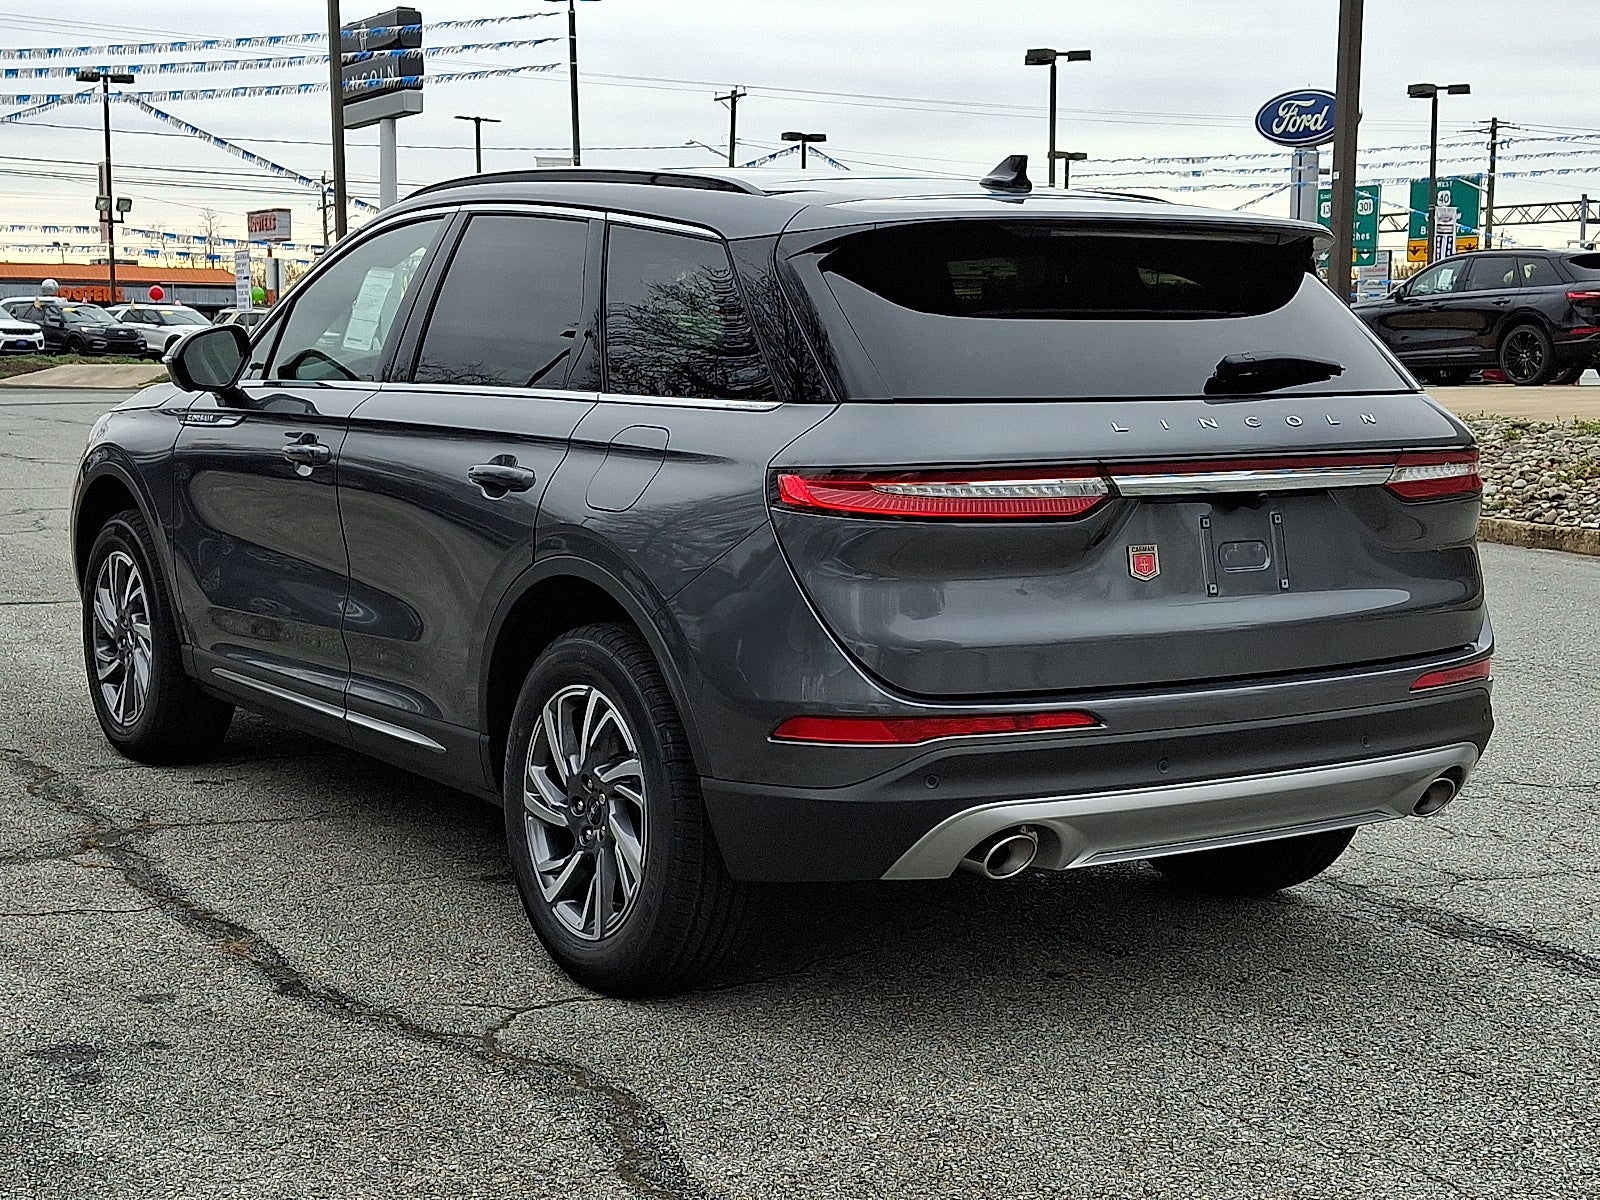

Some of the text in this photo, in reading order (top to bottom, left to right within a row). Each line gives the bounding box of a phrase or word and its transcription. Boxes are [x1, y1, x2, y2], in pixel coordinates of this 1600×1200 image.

[344, 64, 395, 92] INCOLN
[1272, 99, 1329, 134] Ford
[1359, 202, 1372, 213] 301
[1438, 193, 1450, 203] 40
[1111, 413, 1377, 433] LINCOLN
